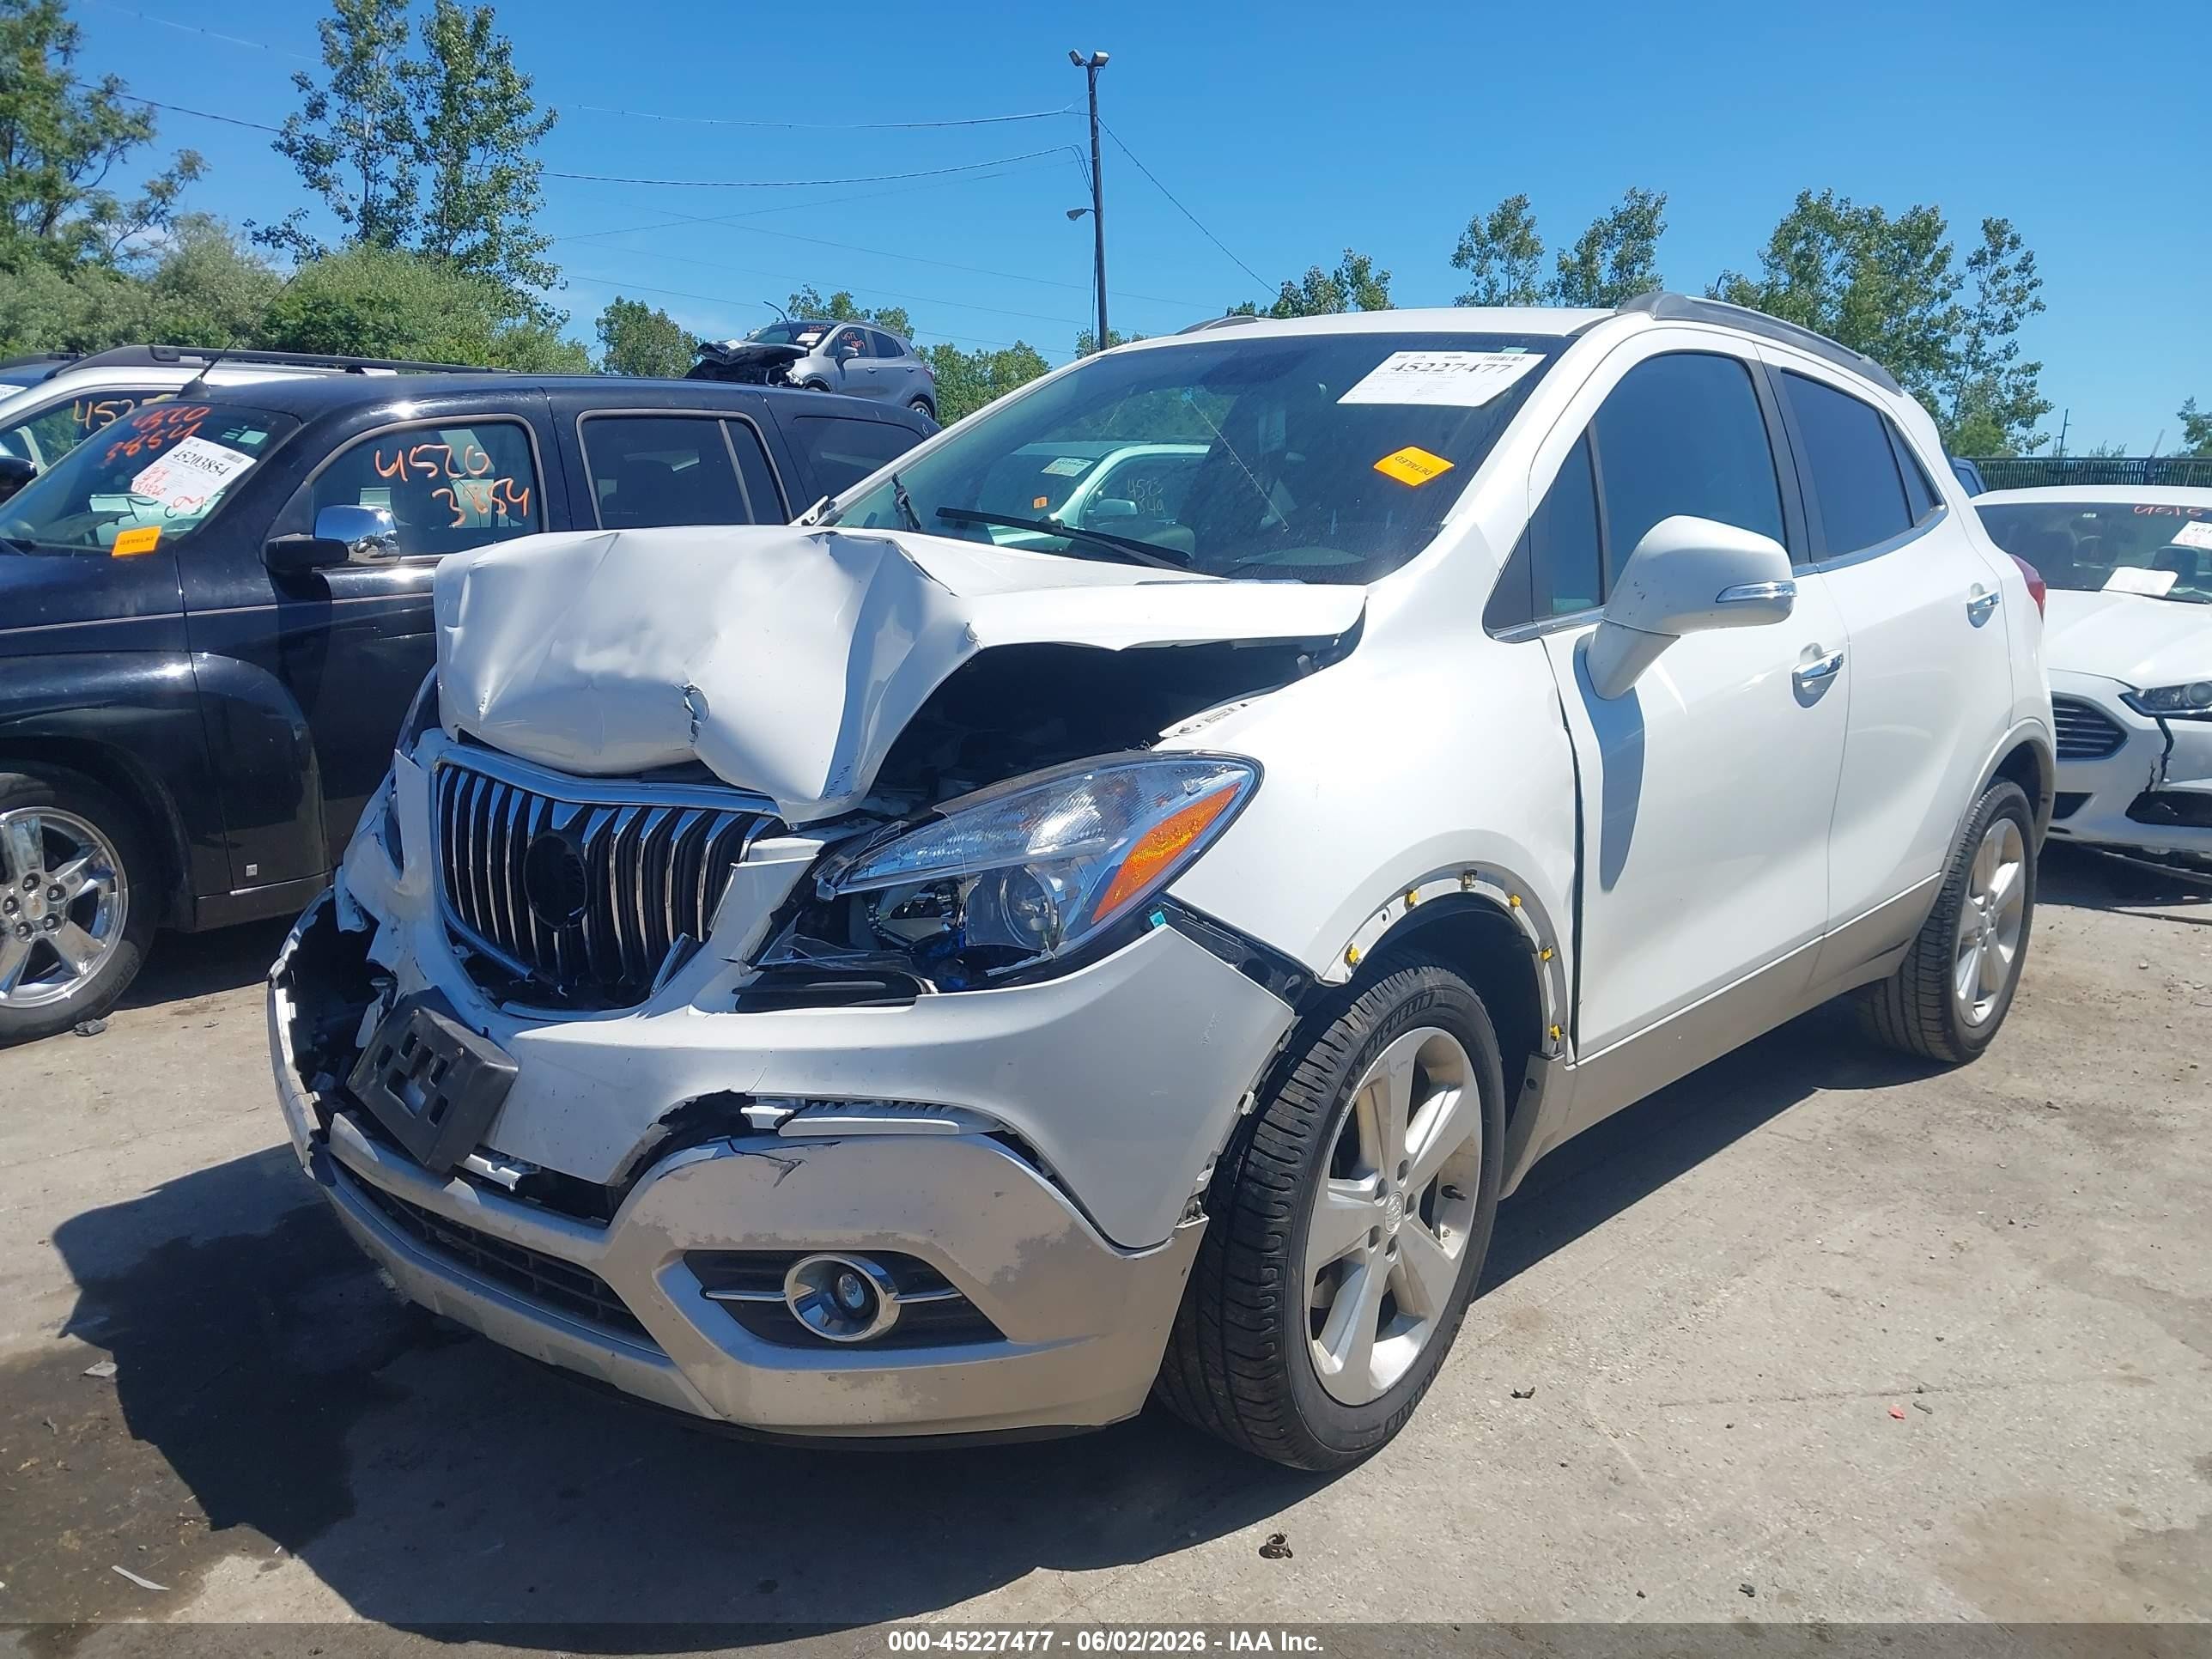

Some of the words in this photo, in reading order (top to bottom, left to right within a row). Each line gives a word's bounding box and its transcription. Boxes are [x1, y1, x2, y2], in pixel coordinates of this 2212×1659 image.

[1390, 362, 1514, 374] 45227477
[131, 406, 211, 433] 4520
[173, 449, 232, 477] 45203854
[375, 444, 490, 482] 4520
[1395, 455, 1433, 476] DETAILED
[1364, 991, 1436, 1064] MICHELIN
